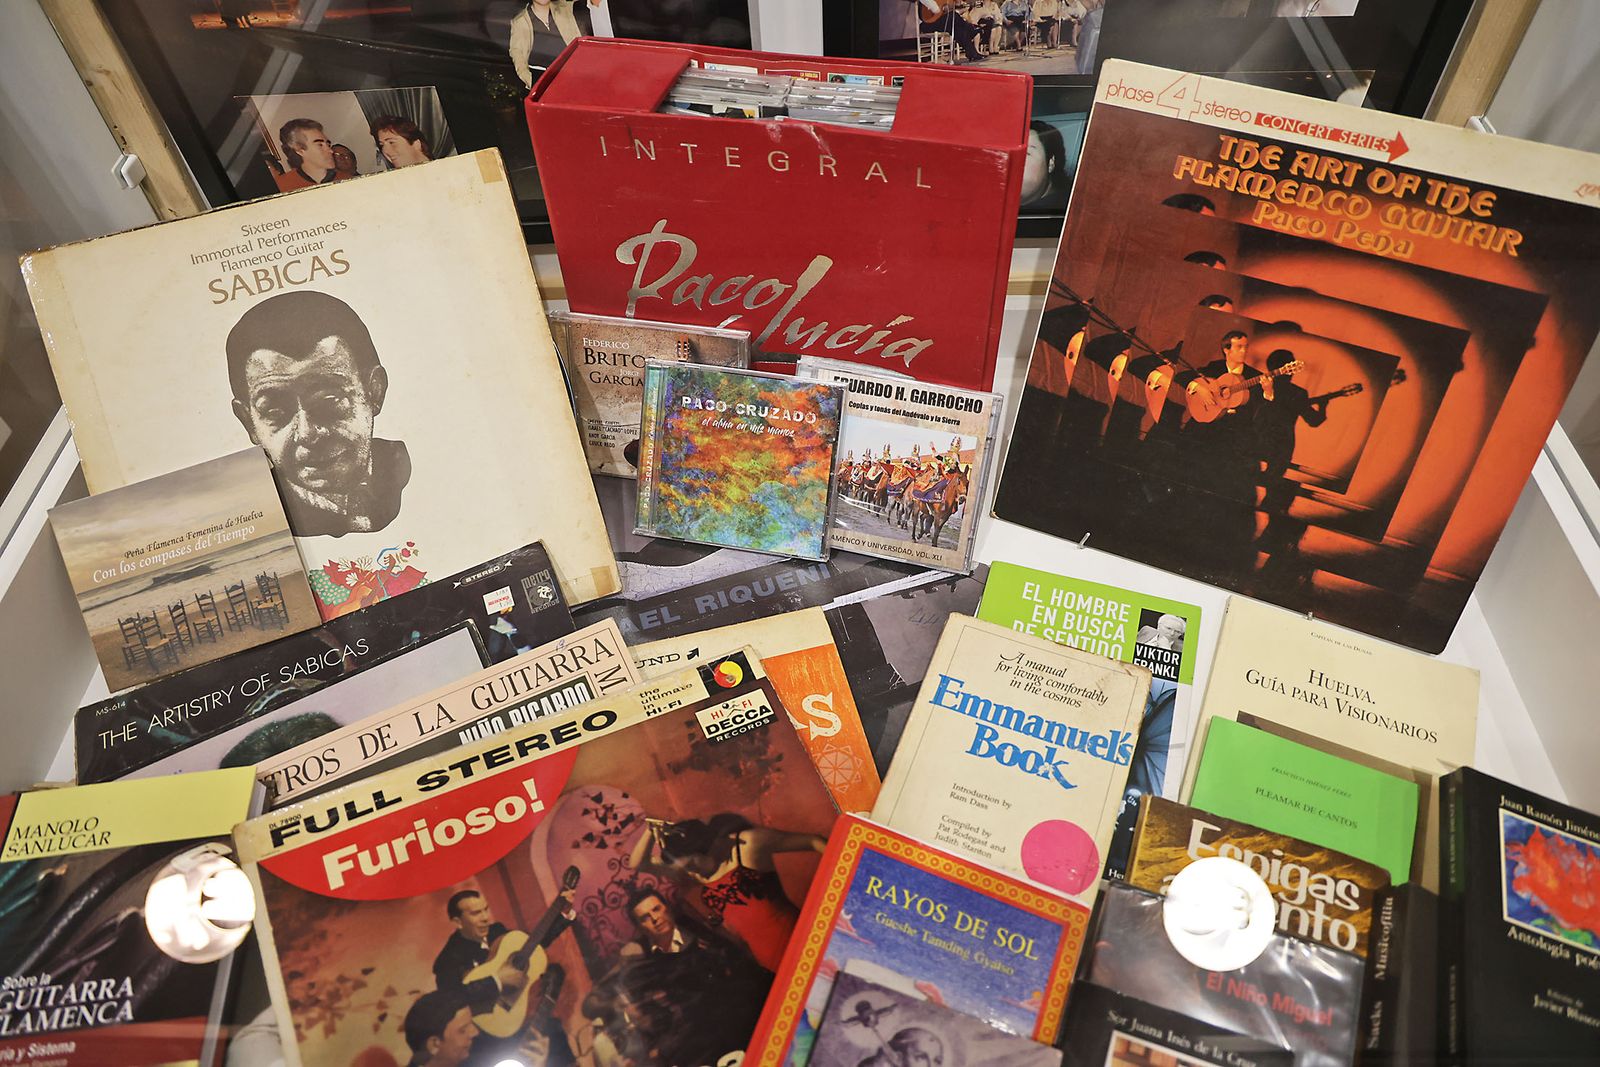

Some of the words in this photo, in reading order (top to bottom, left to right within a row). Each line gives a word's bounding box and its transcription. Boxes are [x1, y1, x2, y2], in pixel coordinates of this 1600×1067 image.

[1105, 80, 1154, 104] phase
[1156, 72, 1202, 120] 4
[1202, 101, 1252, 124] stereo
[1260, 113, 1333, 140] CONCERT
[1339, 128, 1390, 153] SERIES
[600, 136, 932, 188] INTEGRAL
[1218, 134, 1283, 172] THE
[1290, 149, 1363, 190] ART
[1366, 167, 1423, 199] OF
[1427, 177, 1497, 218] THE
[190, 240, 254, 265] Immortal
[257, 218, 348, 249] Performances
[241, 217, 291, 237] Sixteen
[1252, 200, 1327, 239] Paco
[1332, 215, 1417, 260] Peña
[220, 251, 282, 273] Flamenco
[287, 238, 325, 258] Guitar
[616, 219, 792, 318] Paco
[208, 249, 351, 305] SABICAS
[584, 347, 655, 369] BRITO
[681, 396, 727, 413] PACO
[735, 403, 817, 424] CRUZADO
[891, 407, 902, 416] del
[894, 387, 907, 402] H.
[910, 389, 983, 414] GARROCHO
[645, 443, 654, 482] CRUZADO
[124, 547, 145, 560] Peña
[146, 534, 185, 553] Flamenca
[186, 522, 224, 541] Femenina
[225, 518, 235, 528] de
[235, 510, 264, 526] Huelva
[867, 540, 914, 557] UNIVERSIDAD,
[915, 548, 930, 559] VOL.
[93, 568, 117, 583] Con
[119, 559, 137, 574] los
[139, 544, 193, 567] compases
[194, 538, 213, 552] del
[213, 524, 256, 545] Tiempo
[465, 565, 501, 583] STEREO
[694, 564, 832, 613] RIQUENI
[1022, 582, 1043, 603] EL
[1050, 588, 1131, 622] HOMBRE
[1032, 604, 1057, 626] EN
[1062, 612, 1126, 643] BUSCA
[1000, 651, 1025, 664] A
[1026, 658, 1067, 679] manual
[1135, 644, 1180, 666] VIKTOR
[98, 725, 139, 751] THE
[146, 685, 235, 733] ARTISTRY
[239, 674, 272, 696] OF
[279, 638, 371, 683] SABICAS
[360, 723, 399, 761] DE
[412, 701, 457, 738] LA
[471, 637, 615, 710] GUITARRA
[640, 687, 660, 698] the
[994, 660, 1013, 674] for
[1013, 666, 1044, 684] living
[1045, 677, 1109, 706] comfortably
[1009, 678, 1022, 689] in
[1024, 682, 1042, 696] the
[1042, 691, 1082, 708] cosmos
[95, 701, 127, 716] MS-614
[646, 700, 683, 717] HI-FI
[705, 705, 772, 735] DECCA
[710, 710, 724, 720] HI
[742, 699, 753, 709] FI
[928, 673, 1134, 767] Emmanuel's
[1291, 685, 1329, 710] PARA
[1334, 697, 1438, 745] VISIONARIOS
[716, 718, 771, 742] RECORDS
[965, 722, 1078, 790] Book
[269, 790, 402, 848] FULL
[415, 709, 619, 793] STEREO
[952, 783, 1000, 805] Introduction
[1002, 800, 1012, 810] by
[949, 791, 967, 803] Ram
[970, 798, 989, 810] Dass
[1255, 786, 1301, 809] PLEAMAR
[1303, 804, 1317, 814] DE
[1318, 809, 1358, 829] CANTOS
[1499, 794, 1523, 812] Juan
[1526, 804, 1562, 827] Ramón
[13, 816, 99, 841] MANOLO
[322, 777, 546, 891] Furioso!
[938, 823, 951, 833] Pat
[953, 829, 988, 847] Rodegast
[990, 844, 1006, 853] and
[941, 814, 980, 834] Compiled
[982, 829, 992, 838] by
[934, 832, 959, 846] Judith
[962, 842, 992, 859] Stanton
[865, 875, 946, 923] RAYOS
[954, 910, 988, 939] DE
[994, 927, 1039, 960] SOL
[921, 930, 970, 960] Tamding
[1375, 897, 1394, 980] Musicofilia
[1507, 926, 1570, 958] Antología
[0, 976, 134, 1012] GUITARRA
[2, 975, 38, 990] Sobre
[40, 972, 51, 985] la
[1206, 972, 1223, 993] El
[1227, 978, 1269, 1006] Niño
[1272, 992, 1333, 1027] Miguel
[1107, 1009, 1127, 1026] Sor
[1130, 1018, 1163, 1039] Juana
[1166, 1030, 1191, 1048] Inés
[1194, 1041, 1209, 1055] de
[1212, 1046, 1223, 1060] la
[1367, 1001, 1383, 1049] Sacks
[15, 1048, 26, 1063] y
[27, 1041, 76, 1058] Sistema
